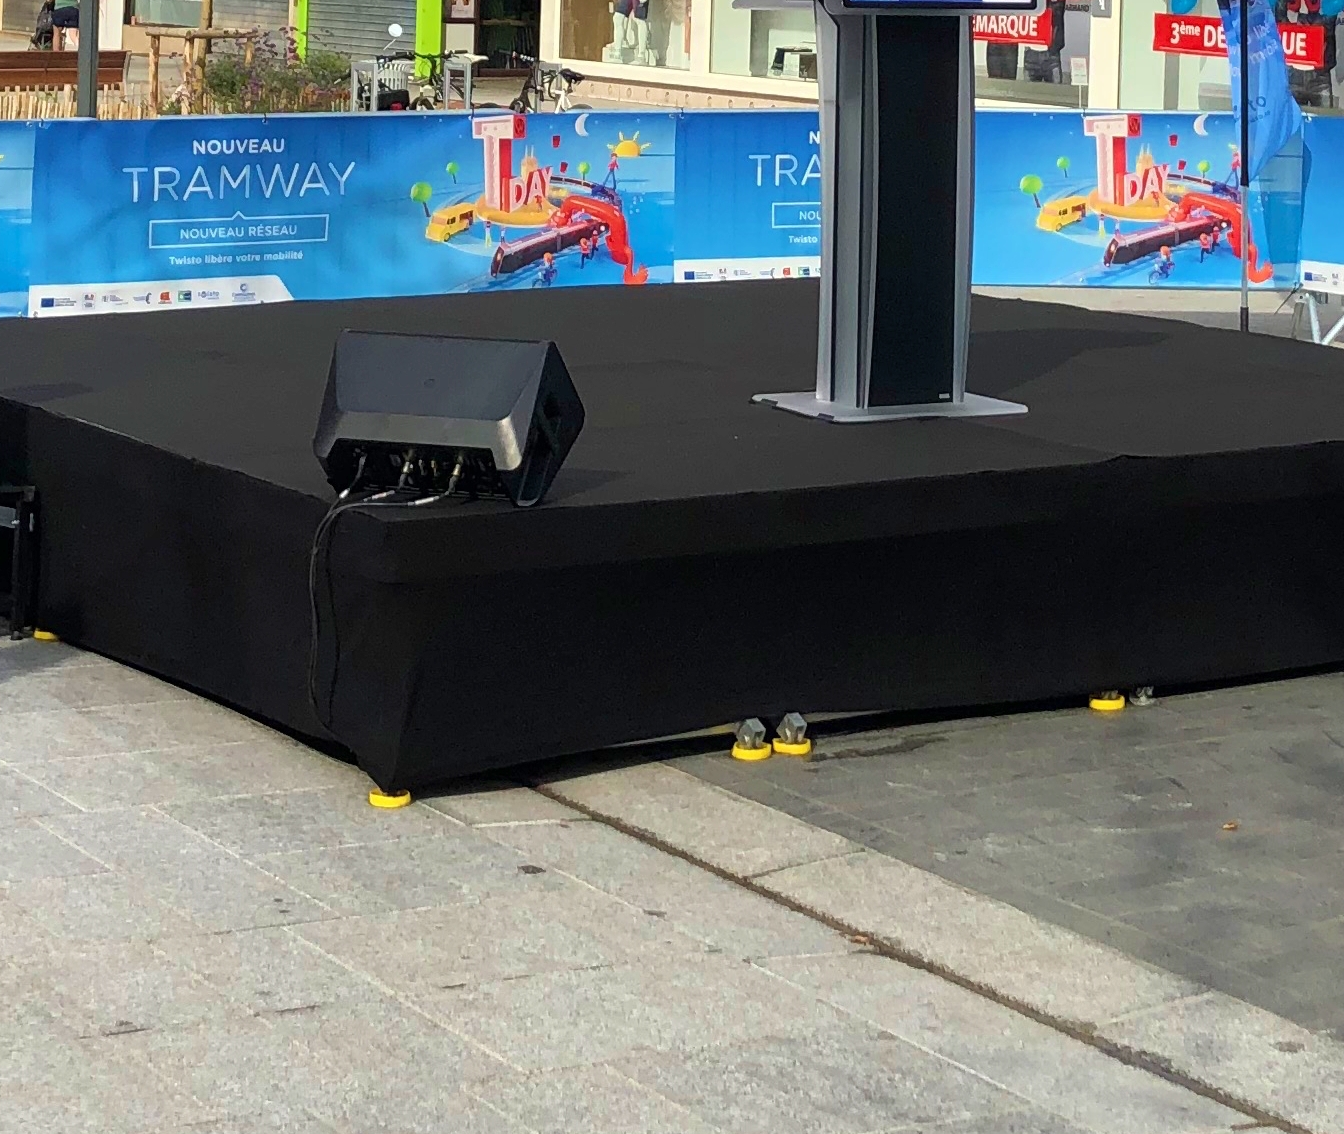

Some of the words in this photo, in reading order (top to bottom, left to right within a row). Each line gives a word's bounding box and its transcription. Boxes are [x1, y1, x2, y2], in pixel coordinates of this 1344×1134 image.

[973, 14, 1038, 38] MARQUE
[1170, 22, 1201, 45] 3ème
[192, 138, 286, 155] NOUVEAU
[472, 115, 526, 211] T
[501, 166, 553, 213] DAY
[1084, 114, 1142, 207] T
[1115, 163, 1169, 207] DAY
[122, 162, 356, 203] TRAMWAY
[180, 226, 245, 240] NOUVEAU
[248, 223, 298, 237] RÉSEAU
[788, 235, 818, 244] Twisto
[169, 256, 202, 266] Twisto
[205, 253, 233, 264] libère
[235, 253, 261, 262] votre
[263, 250, 304, 262] mobilité
